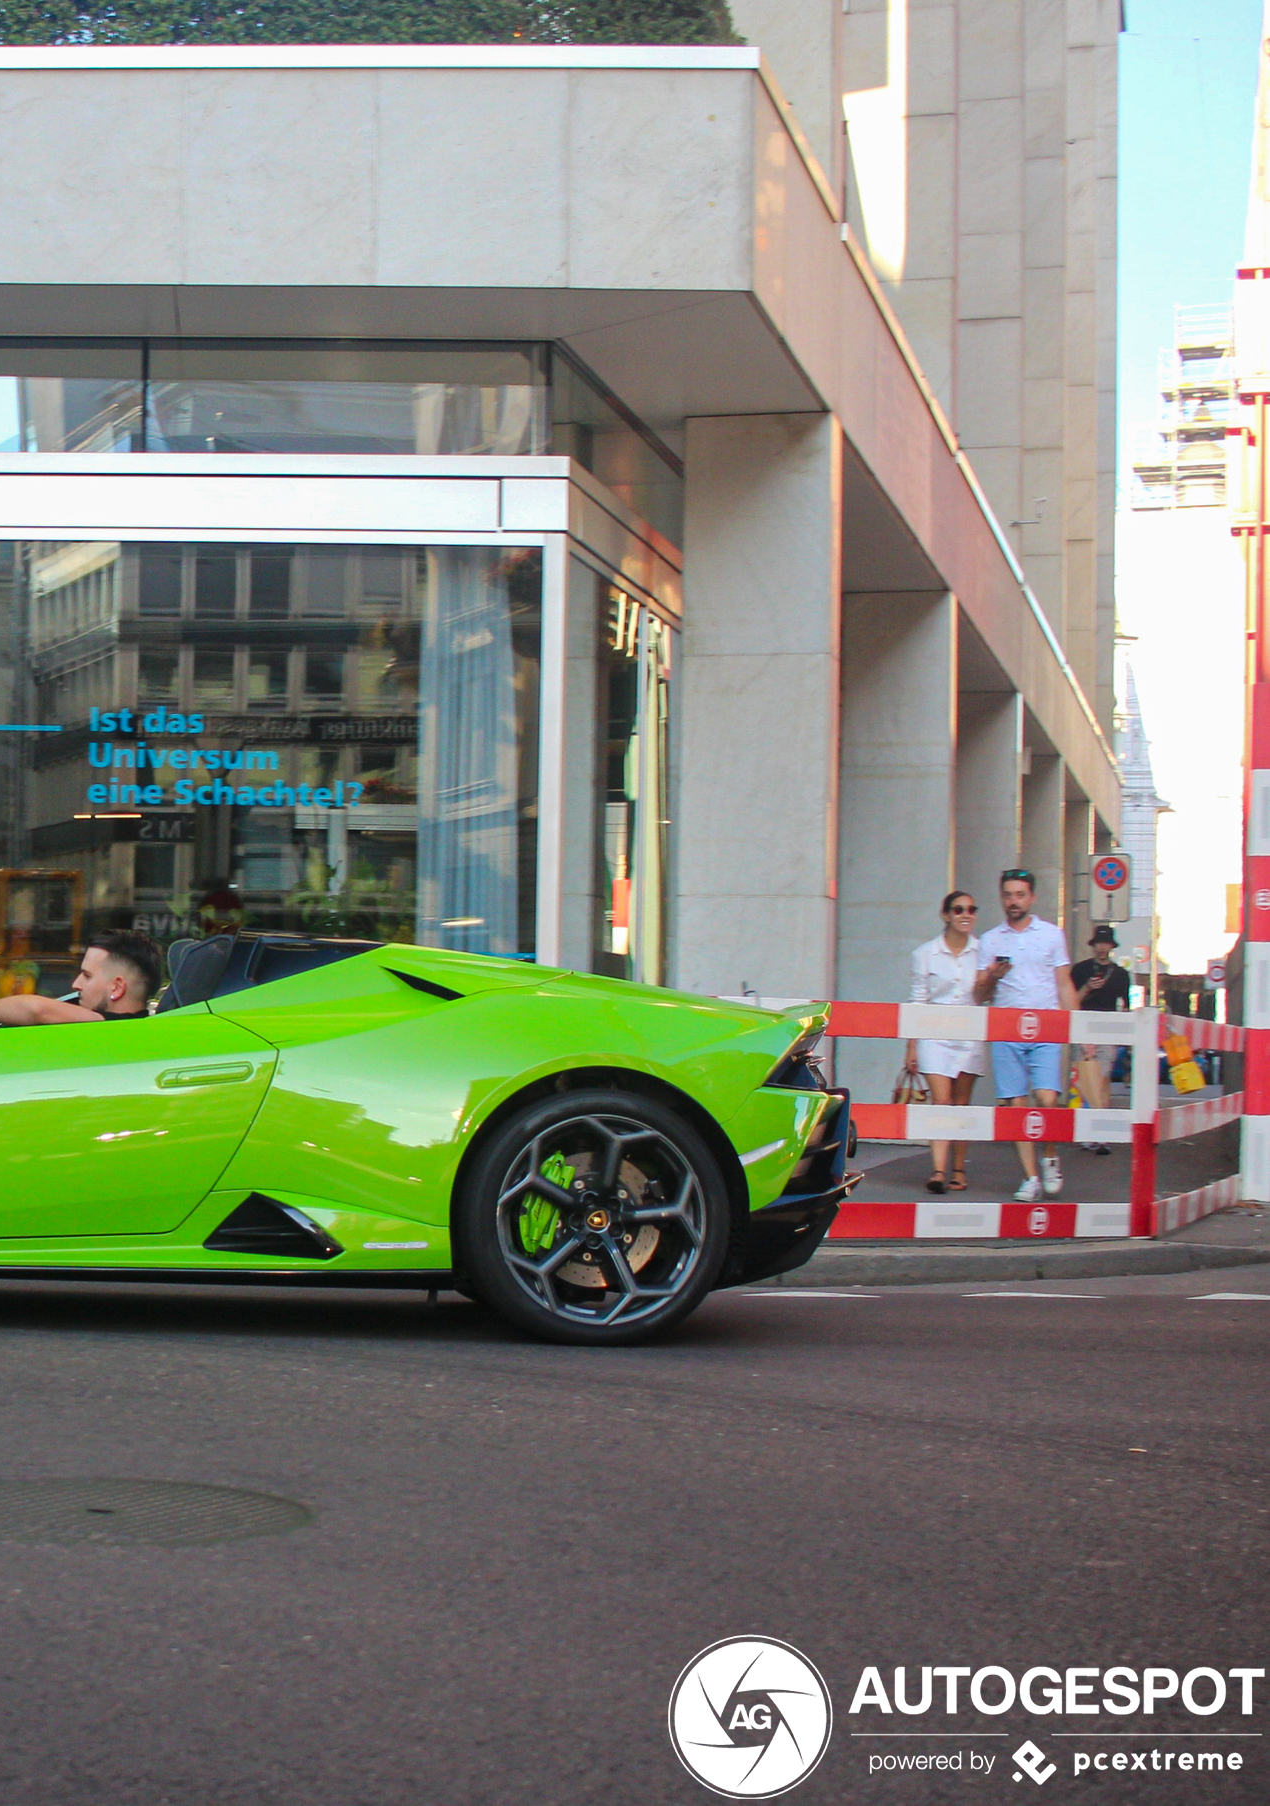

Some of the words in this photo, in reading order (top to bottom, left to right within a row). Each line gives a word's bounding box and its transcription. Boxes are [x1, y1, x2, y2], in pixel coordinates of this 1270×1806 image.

[89, 706, 133, 732] Ist
[143, 706, 205, 733] das
[88, 742, 279, 770] Universum
[87, 777, 163, 804] eine
[174, 778, 364, 807] Schachtel?
